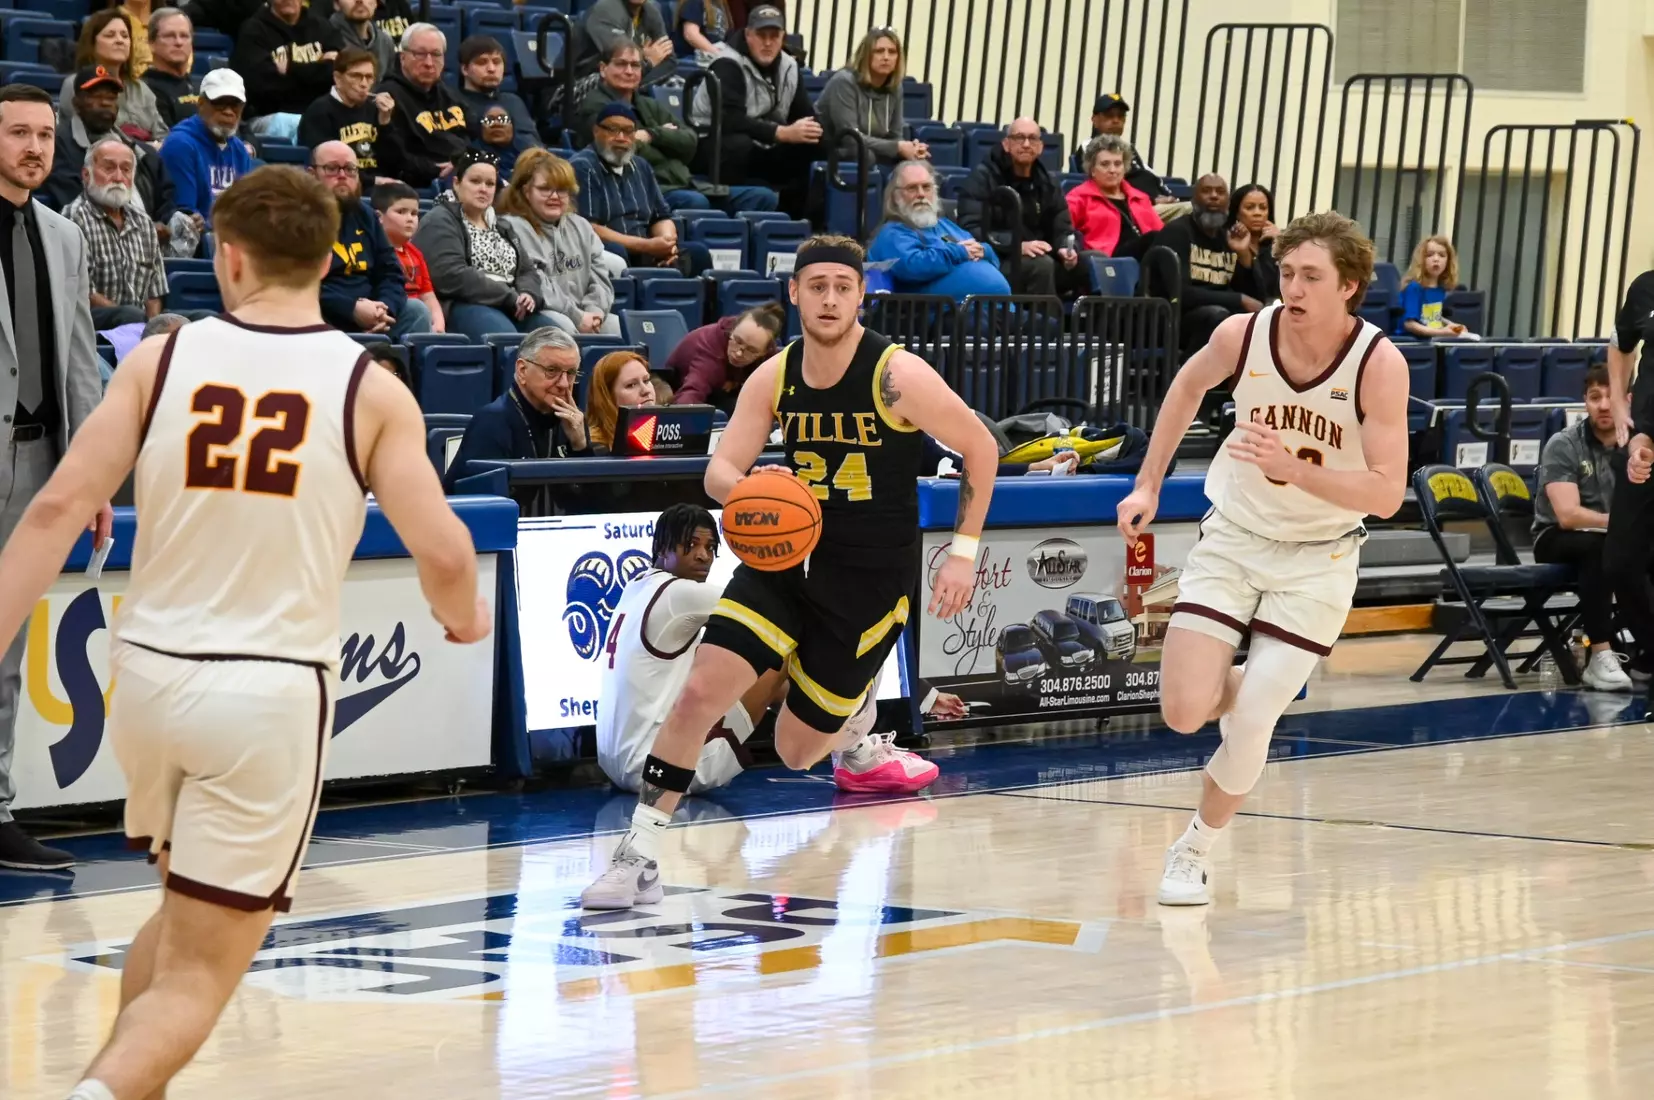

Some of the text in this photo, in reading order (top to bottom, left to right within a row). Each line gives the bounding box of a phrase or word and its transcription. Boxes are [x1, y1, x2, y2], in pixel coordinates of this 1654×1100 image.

[656, 423, 682, 441] POSS.
[776, 411, 883, 446] VILLE
[184, 382, 314, 499] 22
[793, 450, 873, 502] 24
[734, 511, 780, 526] NCAA
[1128, 566, 1152, 576] Clarion
[943, 604, 1003, 676] Style
[1039, 674, 1111, 693] 304.876.2500
[1125, 671, 1160, 687] 304.87
[1039, 694, 1110, 708] All-StarLimousine.com
